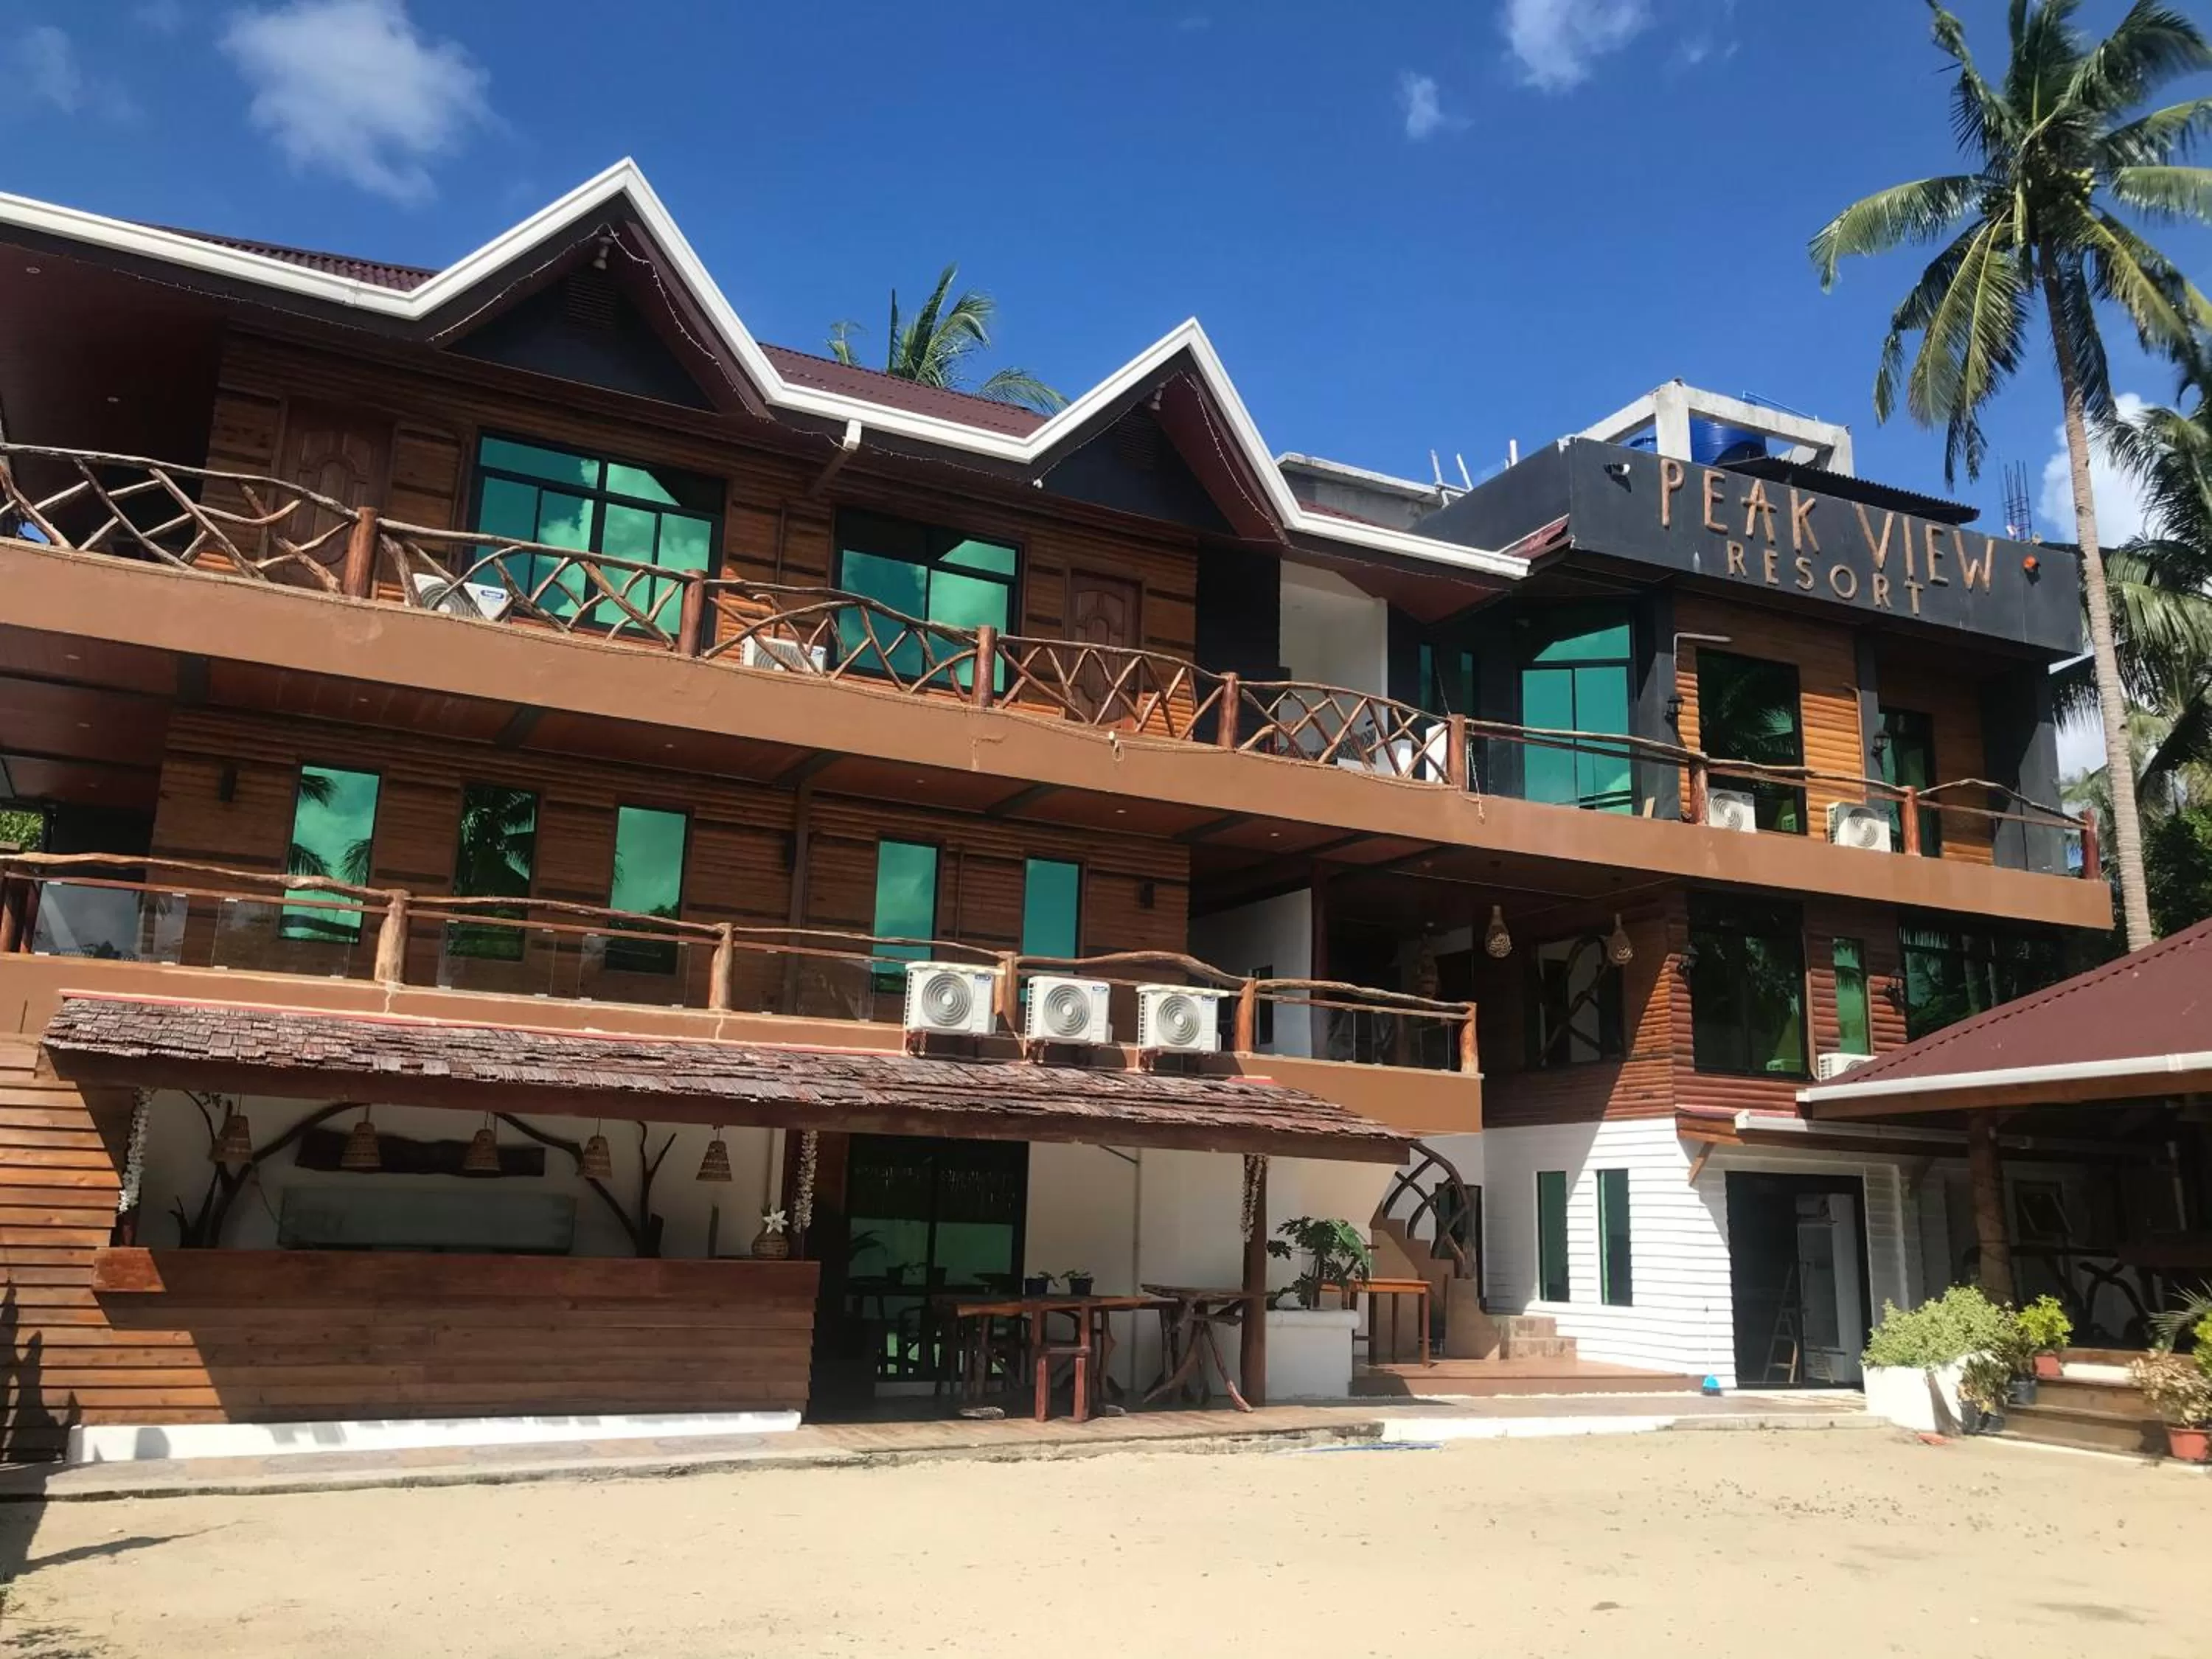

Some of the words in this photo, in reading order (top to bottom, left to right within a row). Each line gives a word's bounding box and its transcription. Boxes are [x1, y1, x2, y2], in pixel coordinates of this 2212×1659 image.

[1660, 458, 1820, 554] PEAK
[1852, 501, 1994, 594] VIEW
[1726, 540, 1924, 616] RESORT
